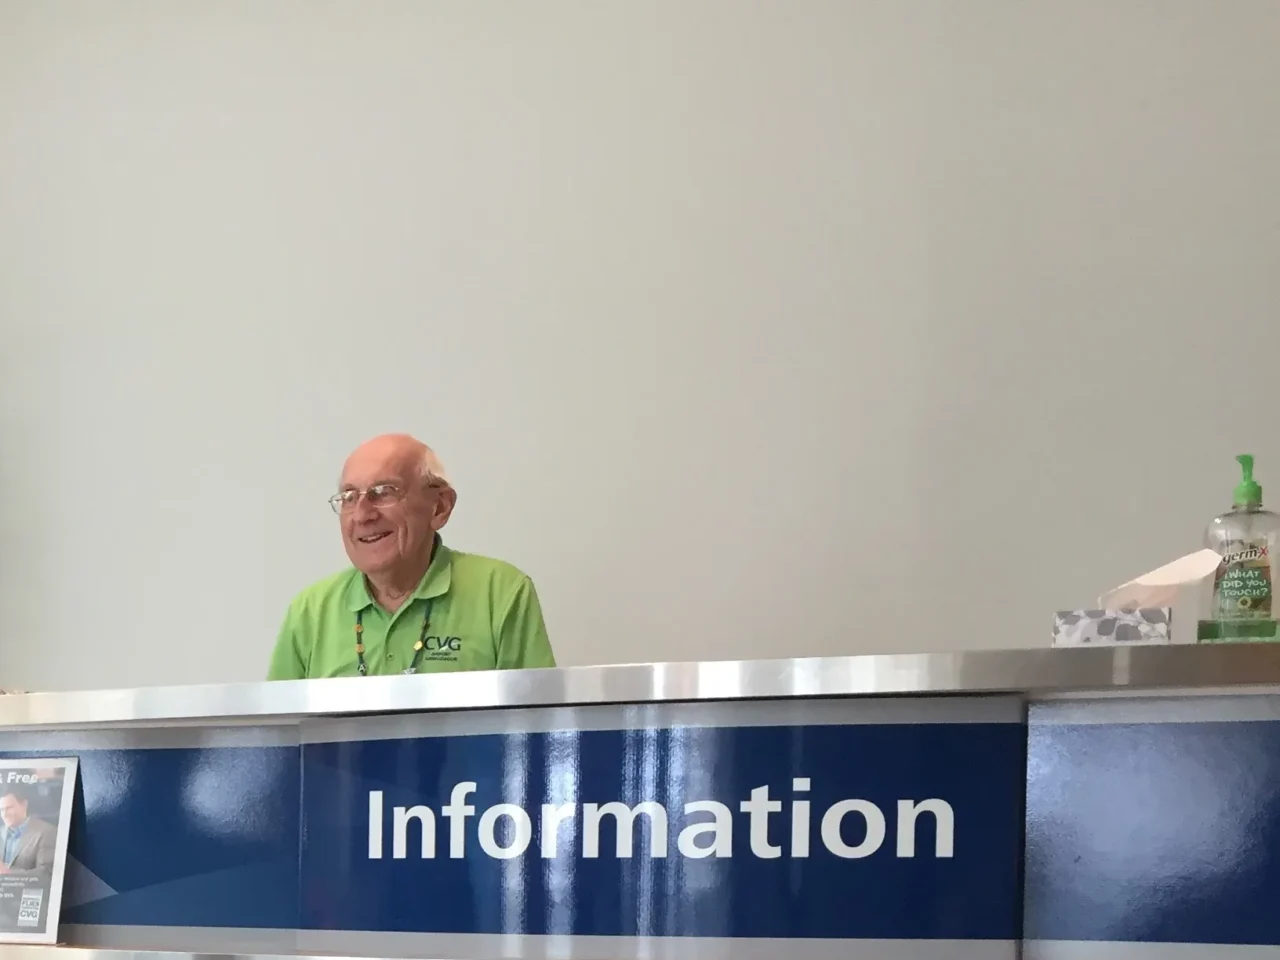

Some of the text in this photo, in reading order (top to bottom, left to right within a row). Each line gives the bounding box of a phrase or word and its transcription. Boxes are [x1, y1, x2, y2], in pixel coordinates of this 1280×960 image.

[1222, 579, 1266, 588] DID YOU
[1222, 588, 1268, 597] TOUCH?
[424, 636, 462, 651] CVG
[7, 772, 39, 784] Free
[368, 777, 955, 860] Information
[20, 910, 38, 918] CVG
